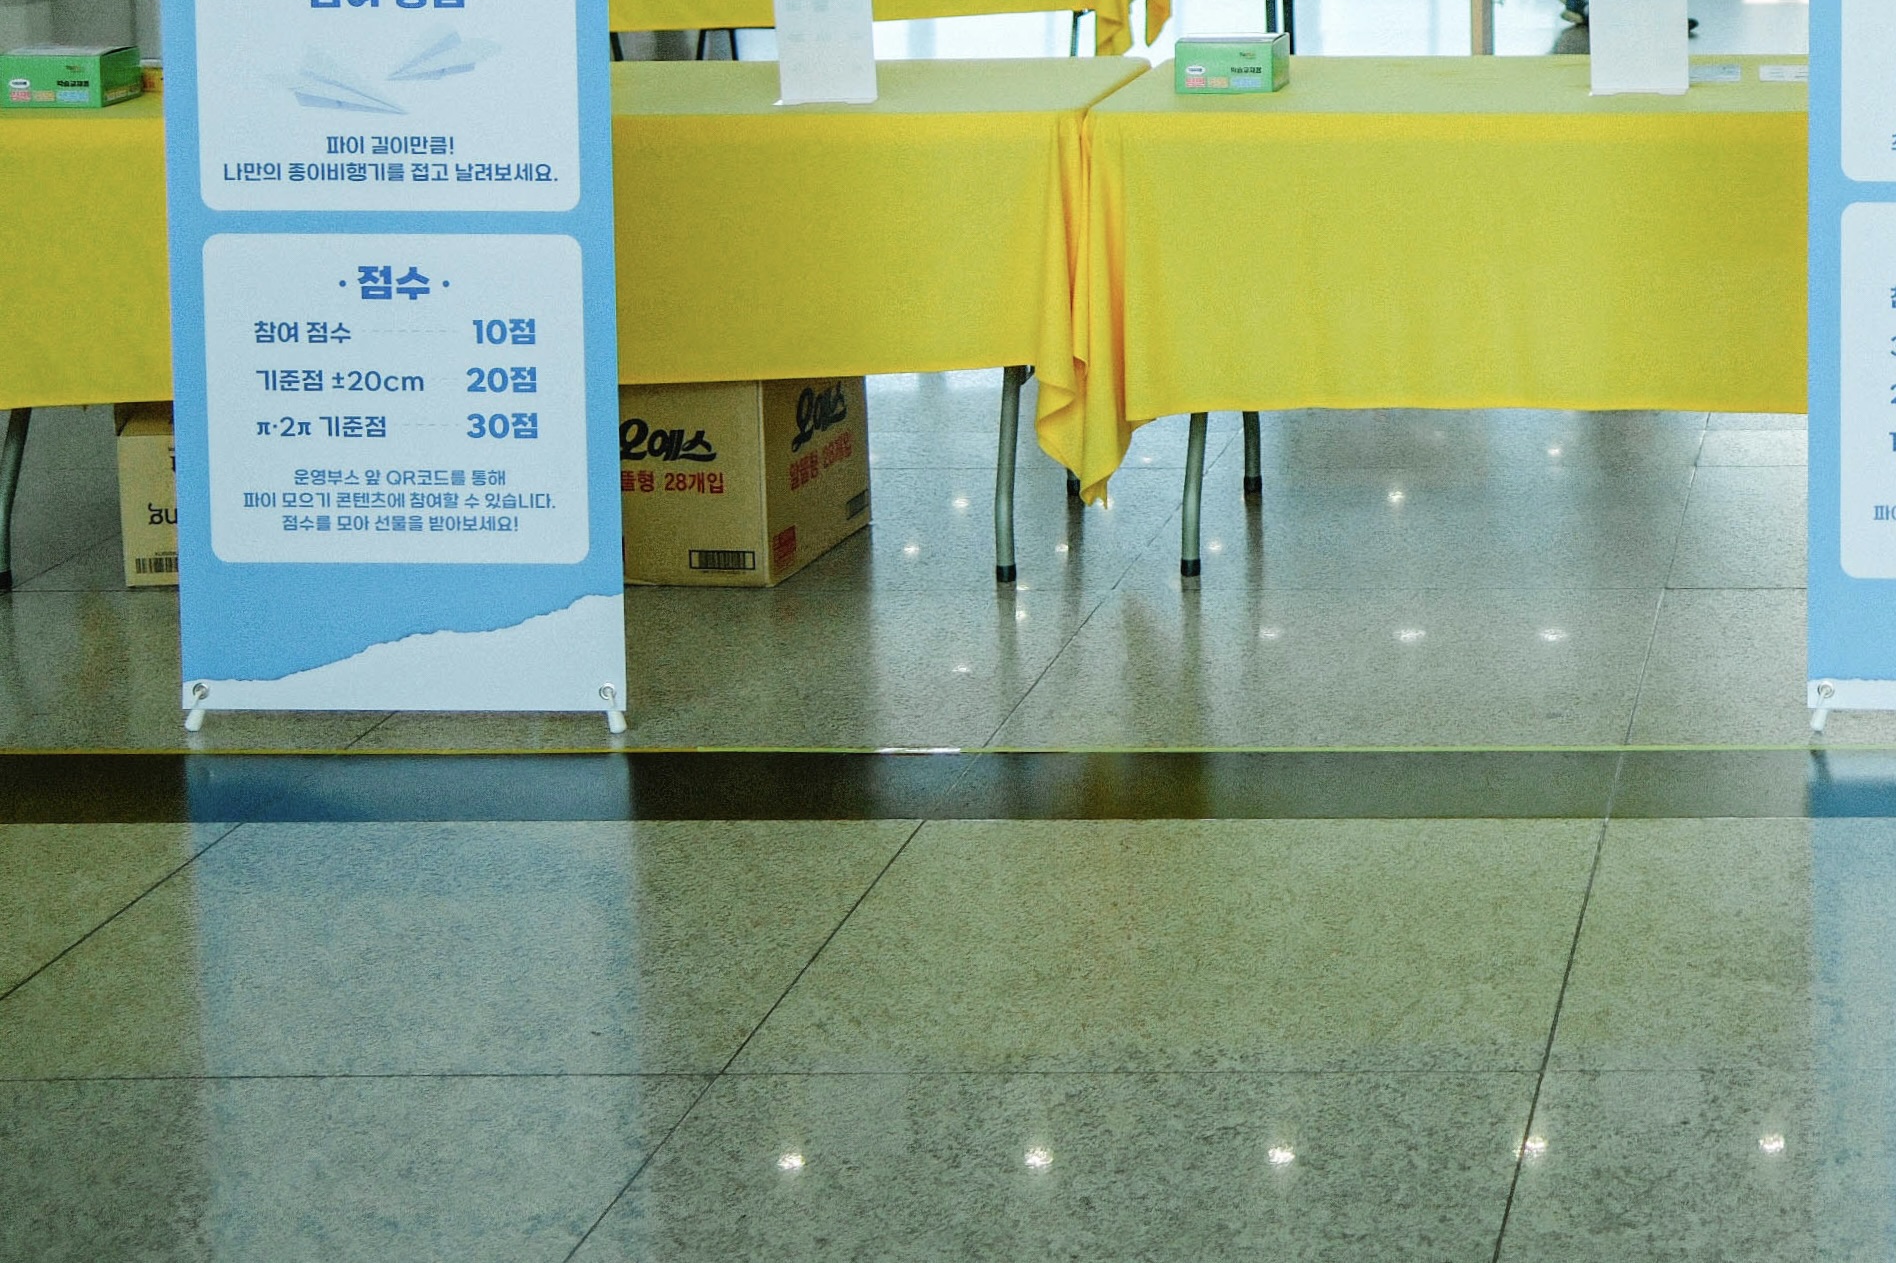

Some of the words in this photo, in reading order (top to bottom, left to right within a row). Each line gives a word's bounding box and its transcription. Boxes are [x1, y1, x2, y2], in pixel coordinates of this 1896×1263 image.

[327, 136, 364, 154] 파이
[371, 136, 453, 154] 길이만큼!
[224, 163, 281, 181] 나만의
[288, 162, 404, 181] 종이비행기를
[411, 163, 448, 181] 접고
[455, 163, 558, 181] 날려보세요.
[358, 266, 430, 300] 점수
[254, 321, 298, 343] 참여
[307, 322, 351, 343] 점수
[473, 319, 535, 344] 10점
[256, 370, 323, 391] 기준점
[332, 371, 424, 392] ±20cm
[467, 367, 536, 393] 20점
[319, 416, 386, 437] 기준점
[467, 413, 538, 439] 30점
[792, 381, 847, 452] 오예스
[620, 419, 717, 461] 오예스
[294, 469, 359, 485] 운영부스
[386, 470, 465, 485] QR코드를
[472, 470, 505, 486] 통해
[664, 471, 724, 494] 28개입
[244, 492, 276, 507] 파이
[283, 493, 330, 507] 모으기
[336, 492, 405, 508] 콘텐츠에
[410, 492, 459, 508] 참여할
[485, 493, 555, 509] 있습니다.
[283, 515, 330, 531] 점수를
[338, 516, 369, 530] 모아
[375, 516, 423, 531] 선물을
[429, 516, 518, 531] 받아보세요!
